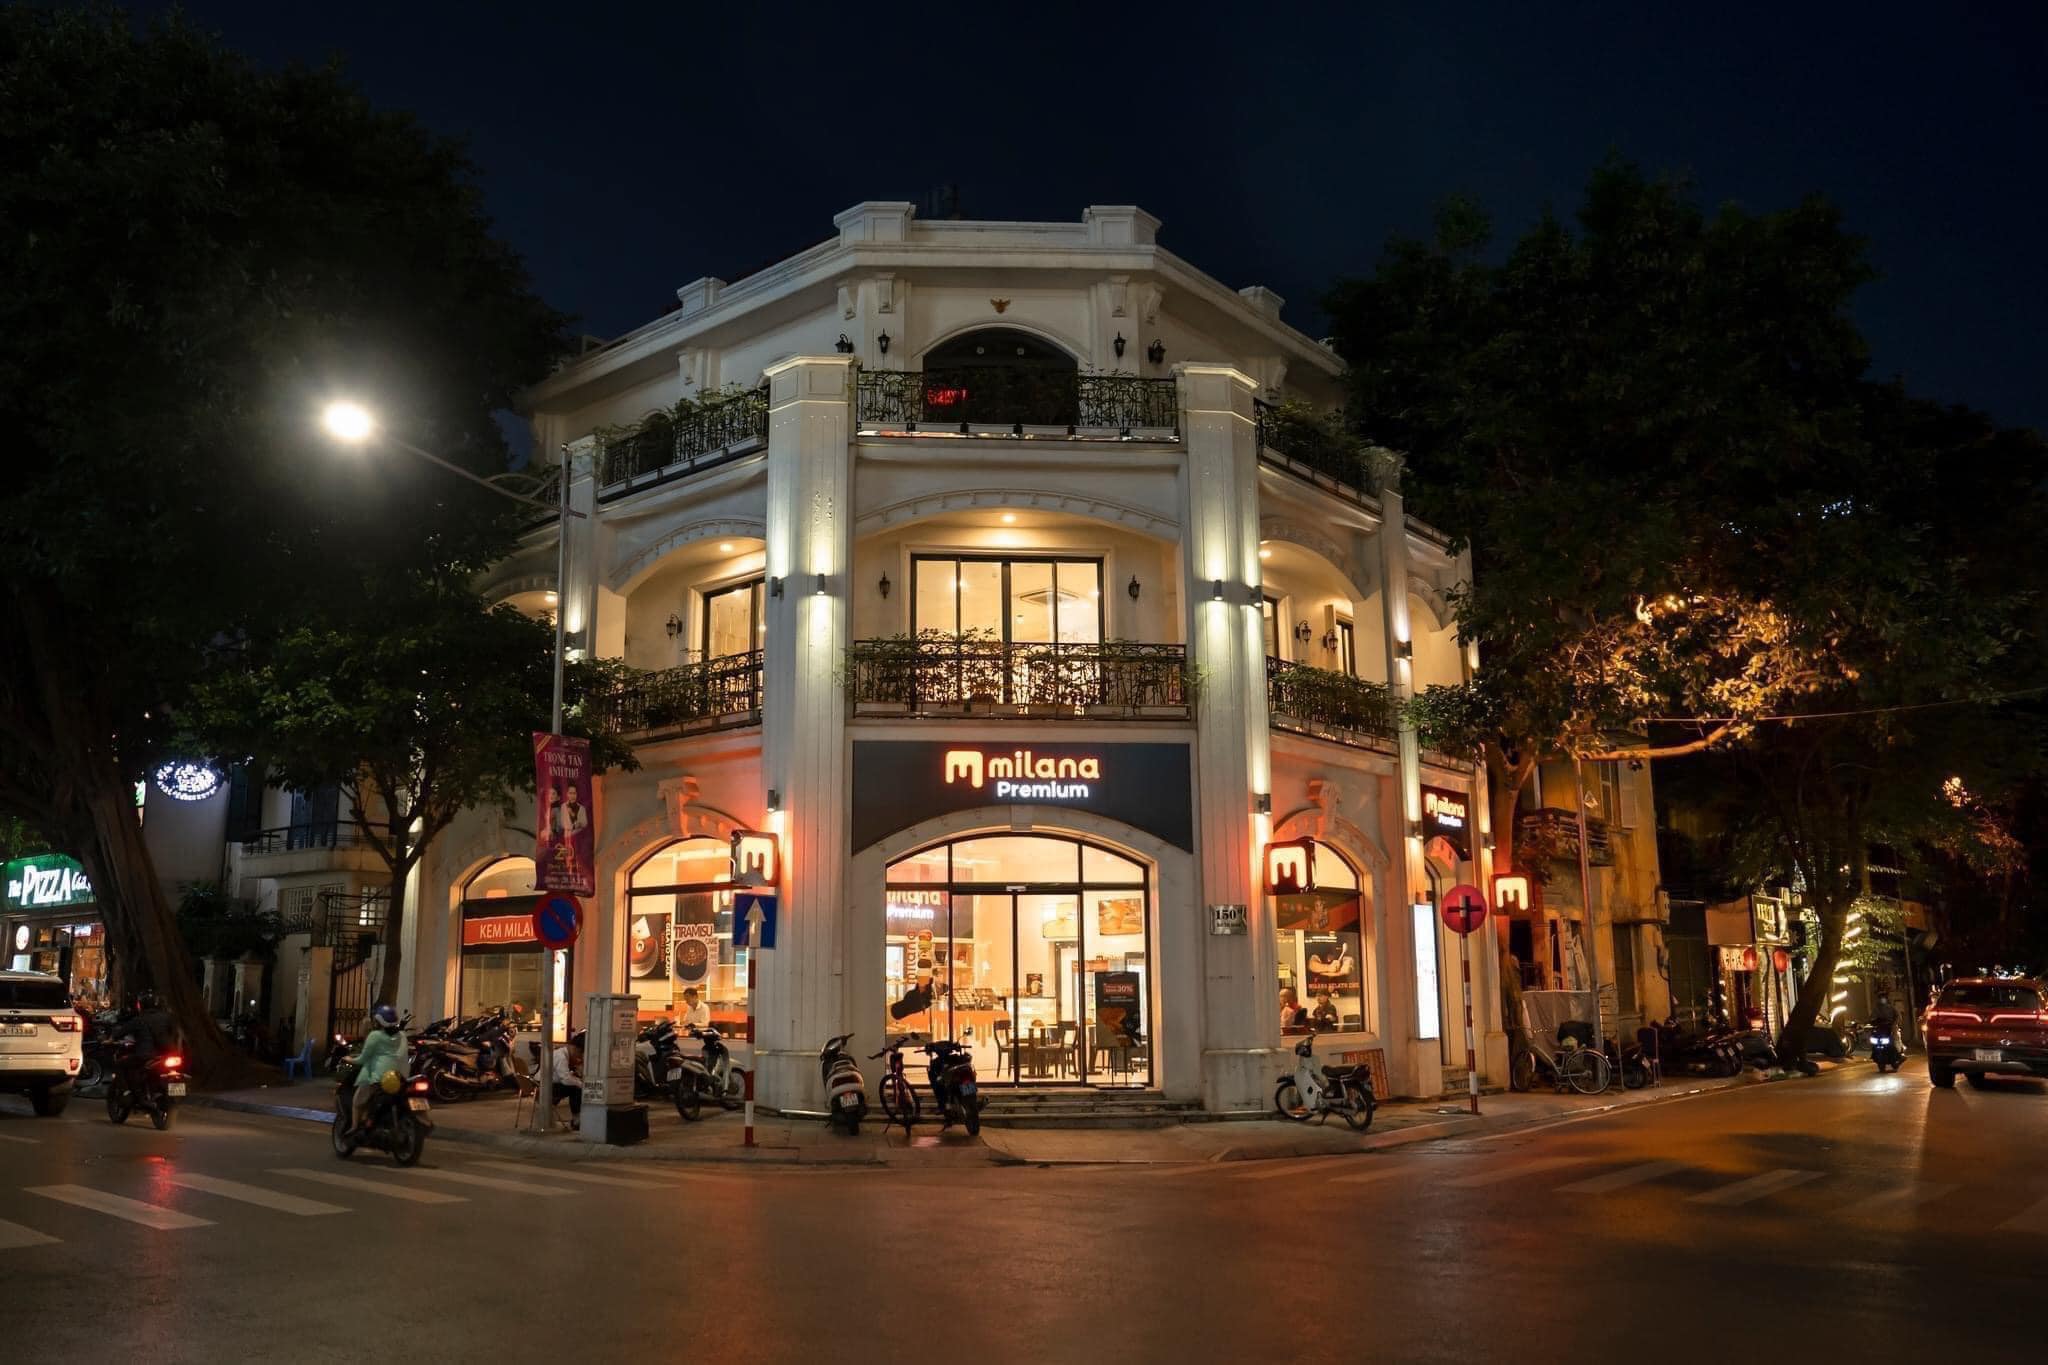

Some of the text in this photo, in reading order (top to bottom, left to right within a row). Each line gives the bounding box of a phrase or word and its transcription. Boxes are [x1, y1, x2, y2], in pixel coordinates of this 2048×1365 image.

[989, 751, 1100, 779] milana
[997, 781, 1089, 798] Premium
[21, 865, 71, 905] PIZZA
[480, 925, 501, 939] KEM
[675, 925, 713, 938] TIRAMISU
